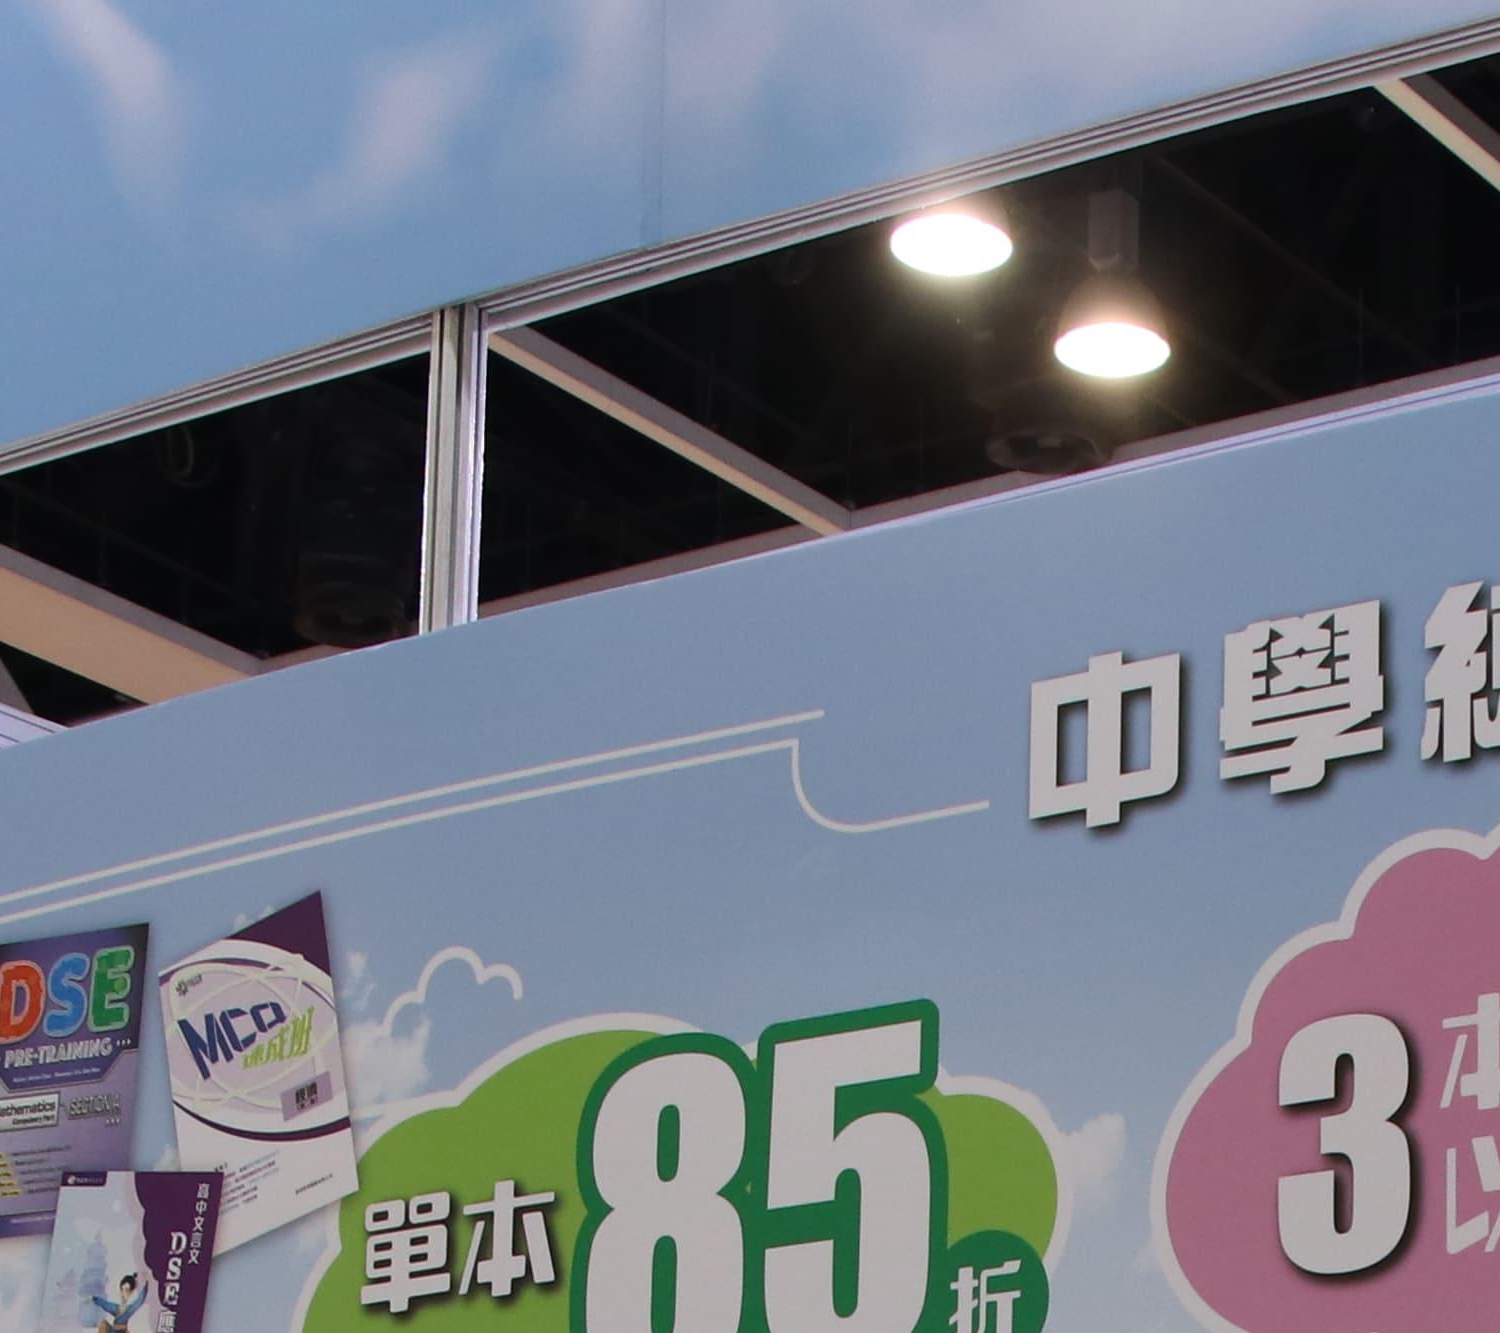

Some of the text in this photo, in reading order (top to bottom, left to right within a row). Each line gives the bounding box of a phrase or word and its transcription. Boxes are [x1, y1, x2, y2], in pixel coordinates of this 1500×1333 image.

[3, 1037, 114, 1071] PRE-TRAINING
[1276, 1010, 1414, 1277] 3
[360, 1180, 556, 1313] 單本
